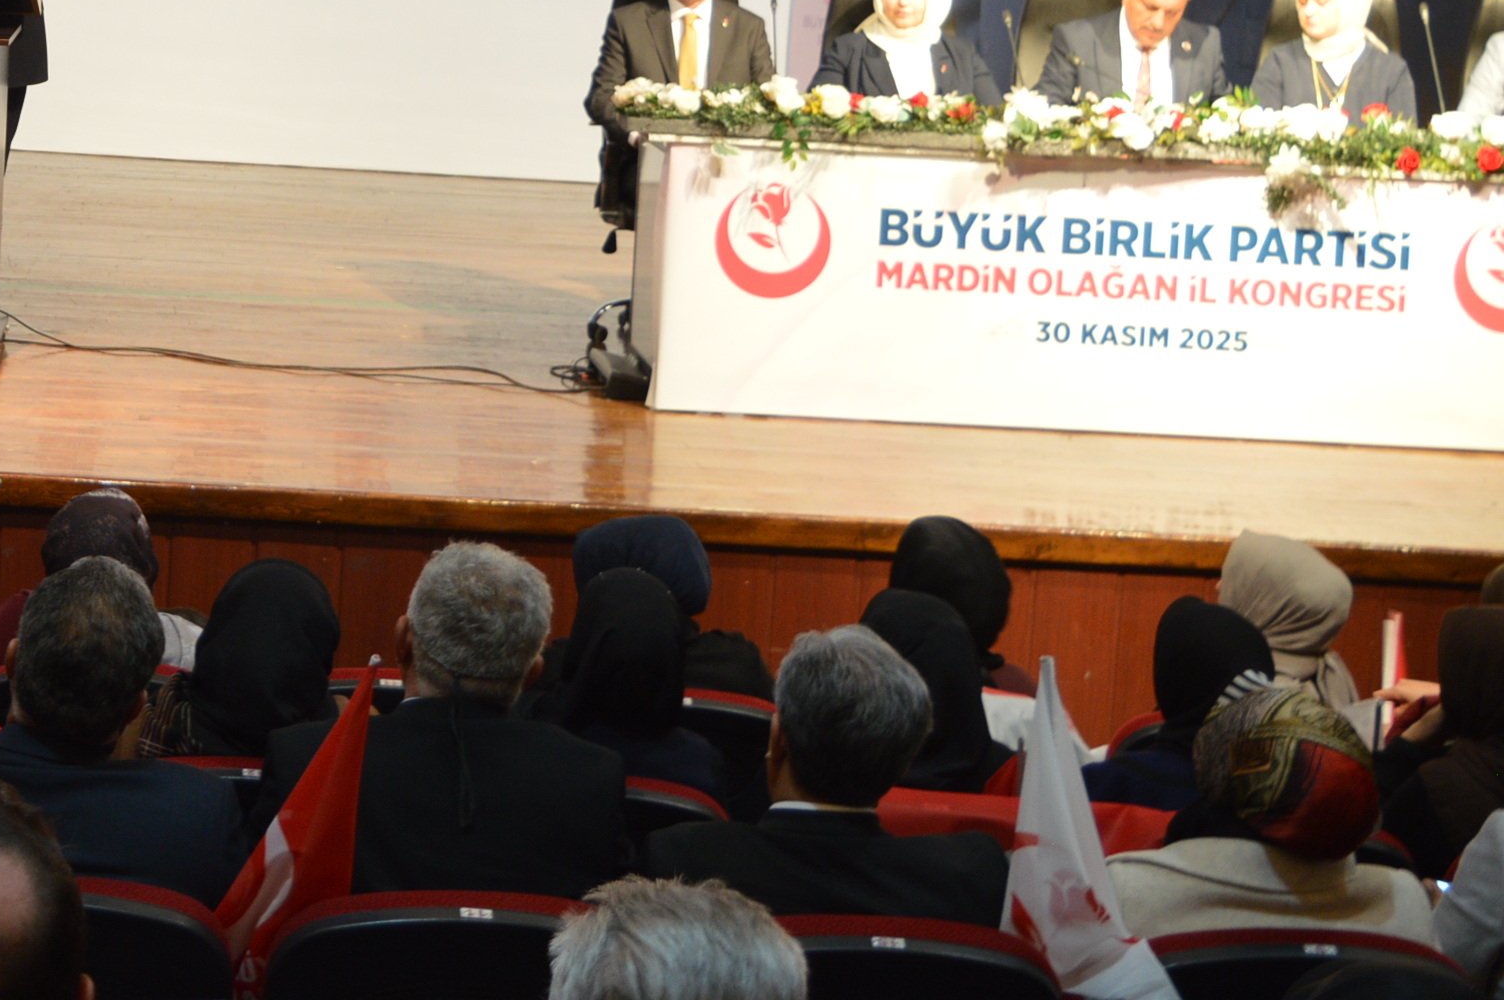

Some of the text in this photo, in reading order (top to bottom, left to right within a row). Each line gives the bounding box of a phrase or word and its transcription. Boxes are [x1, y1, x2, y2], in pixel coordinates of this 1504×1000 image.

[878, 207, 1412, 271] BÜYÜK BİRLİK PARTİSİ
[875, 259, 1406, 313] MARDİN OLAĞAN İL KONGRESİ
[1035, 320, 1249, 353] 30 KASIM 2025
